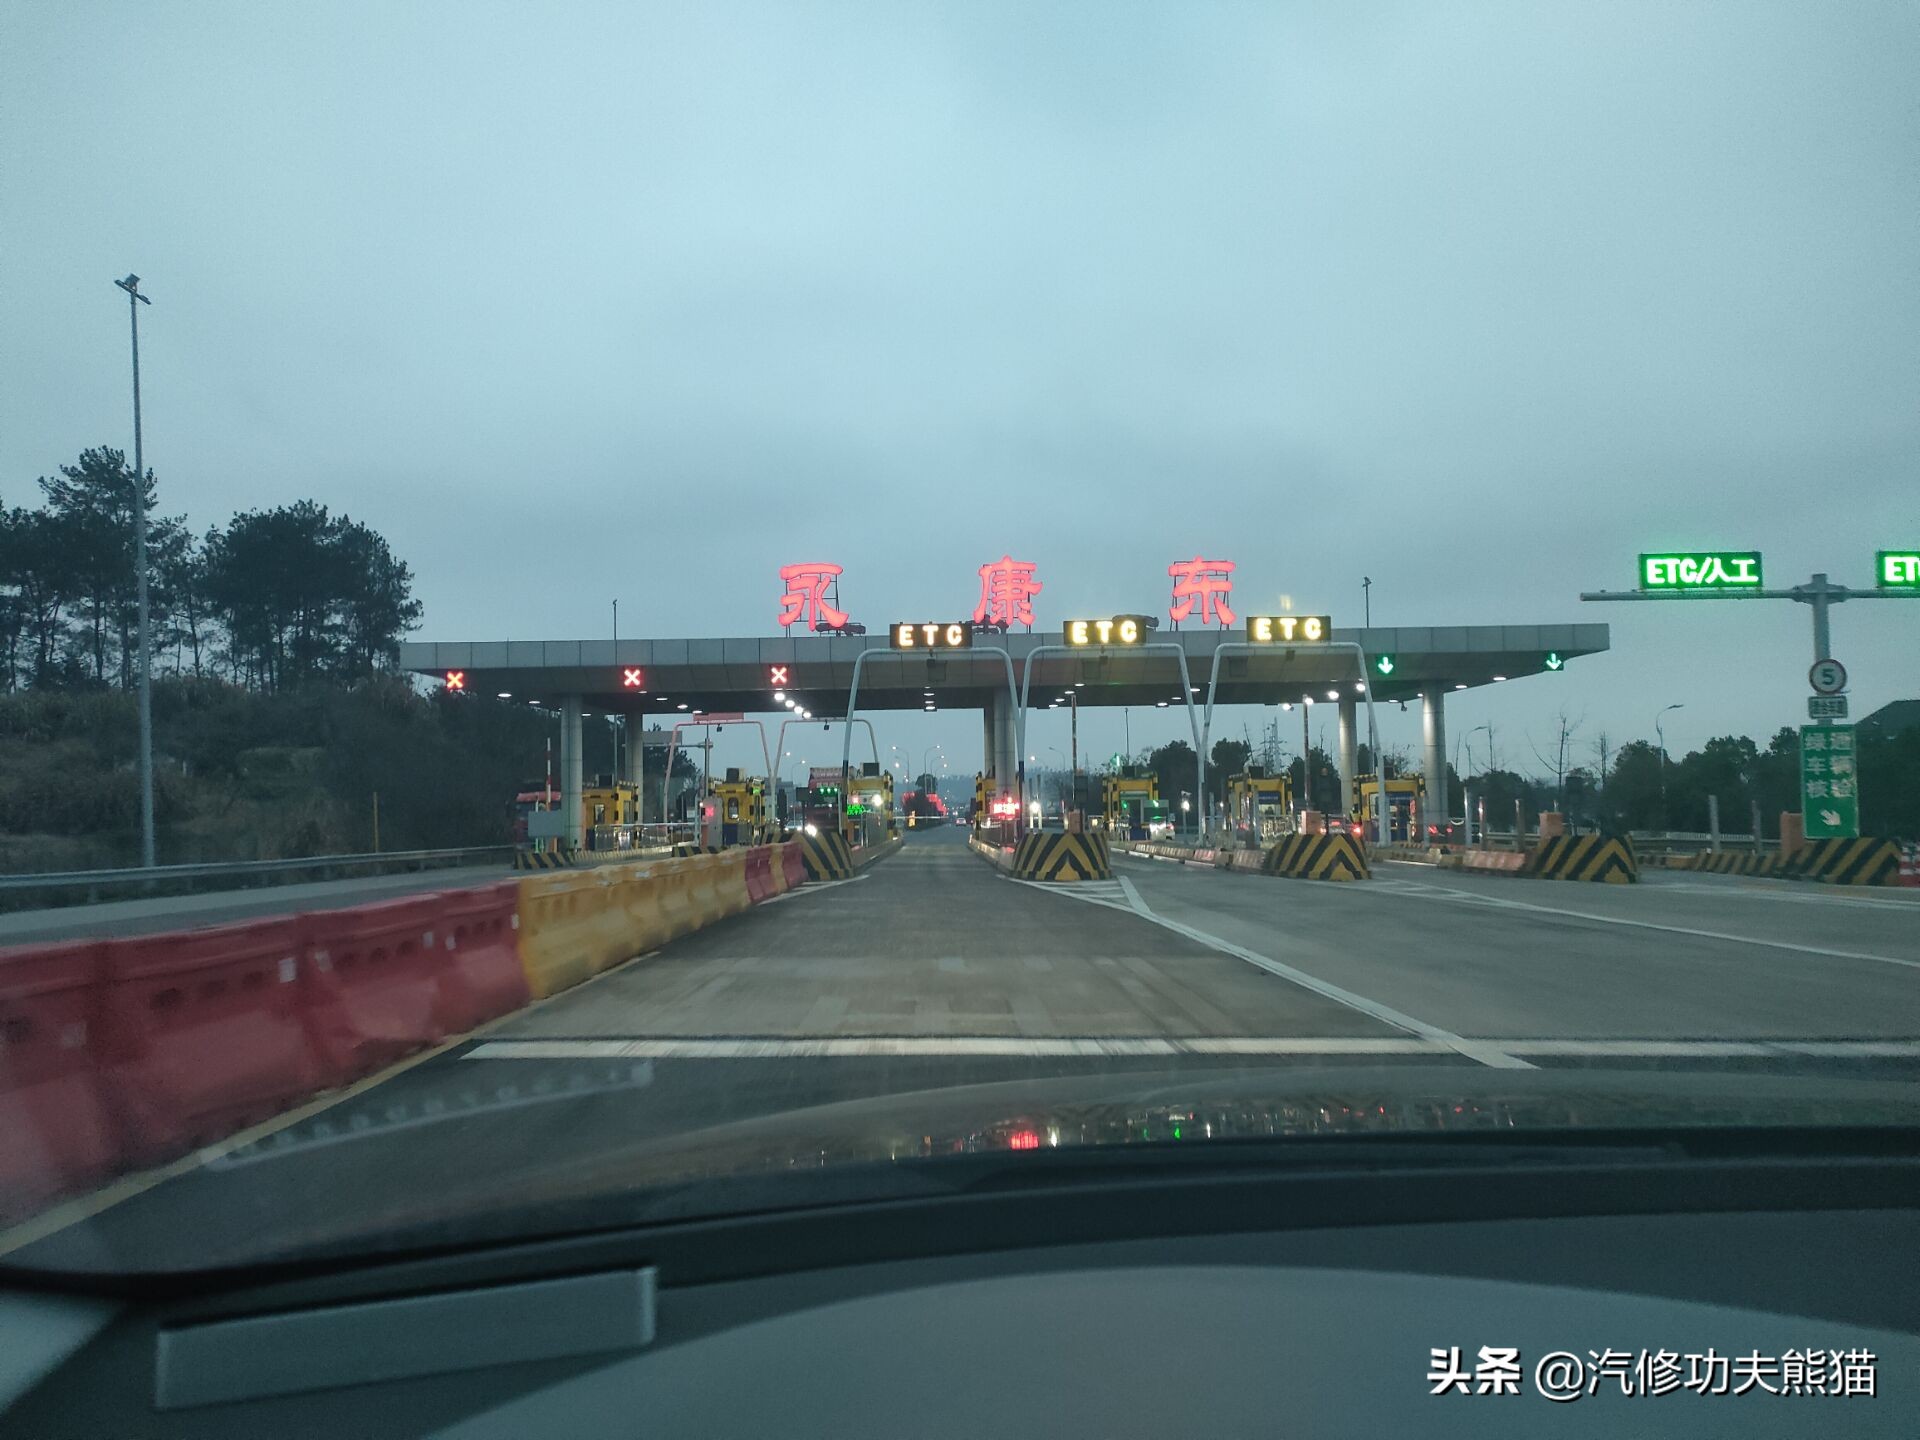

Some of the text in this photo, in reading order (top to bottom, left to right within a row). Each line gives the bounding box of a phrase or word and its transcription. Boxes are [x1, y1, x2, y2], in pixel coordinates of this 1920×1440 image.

[1646, 556, 1759, 585] ETC/人工
[1885, 556, 1920, 582] ET
[897, 625, 964, 647] ETC
[1071, 619, 1138, 645] ETC
[1255, 617, 1323, 641] ETC
[1822, 668, 1836, 686] 5
